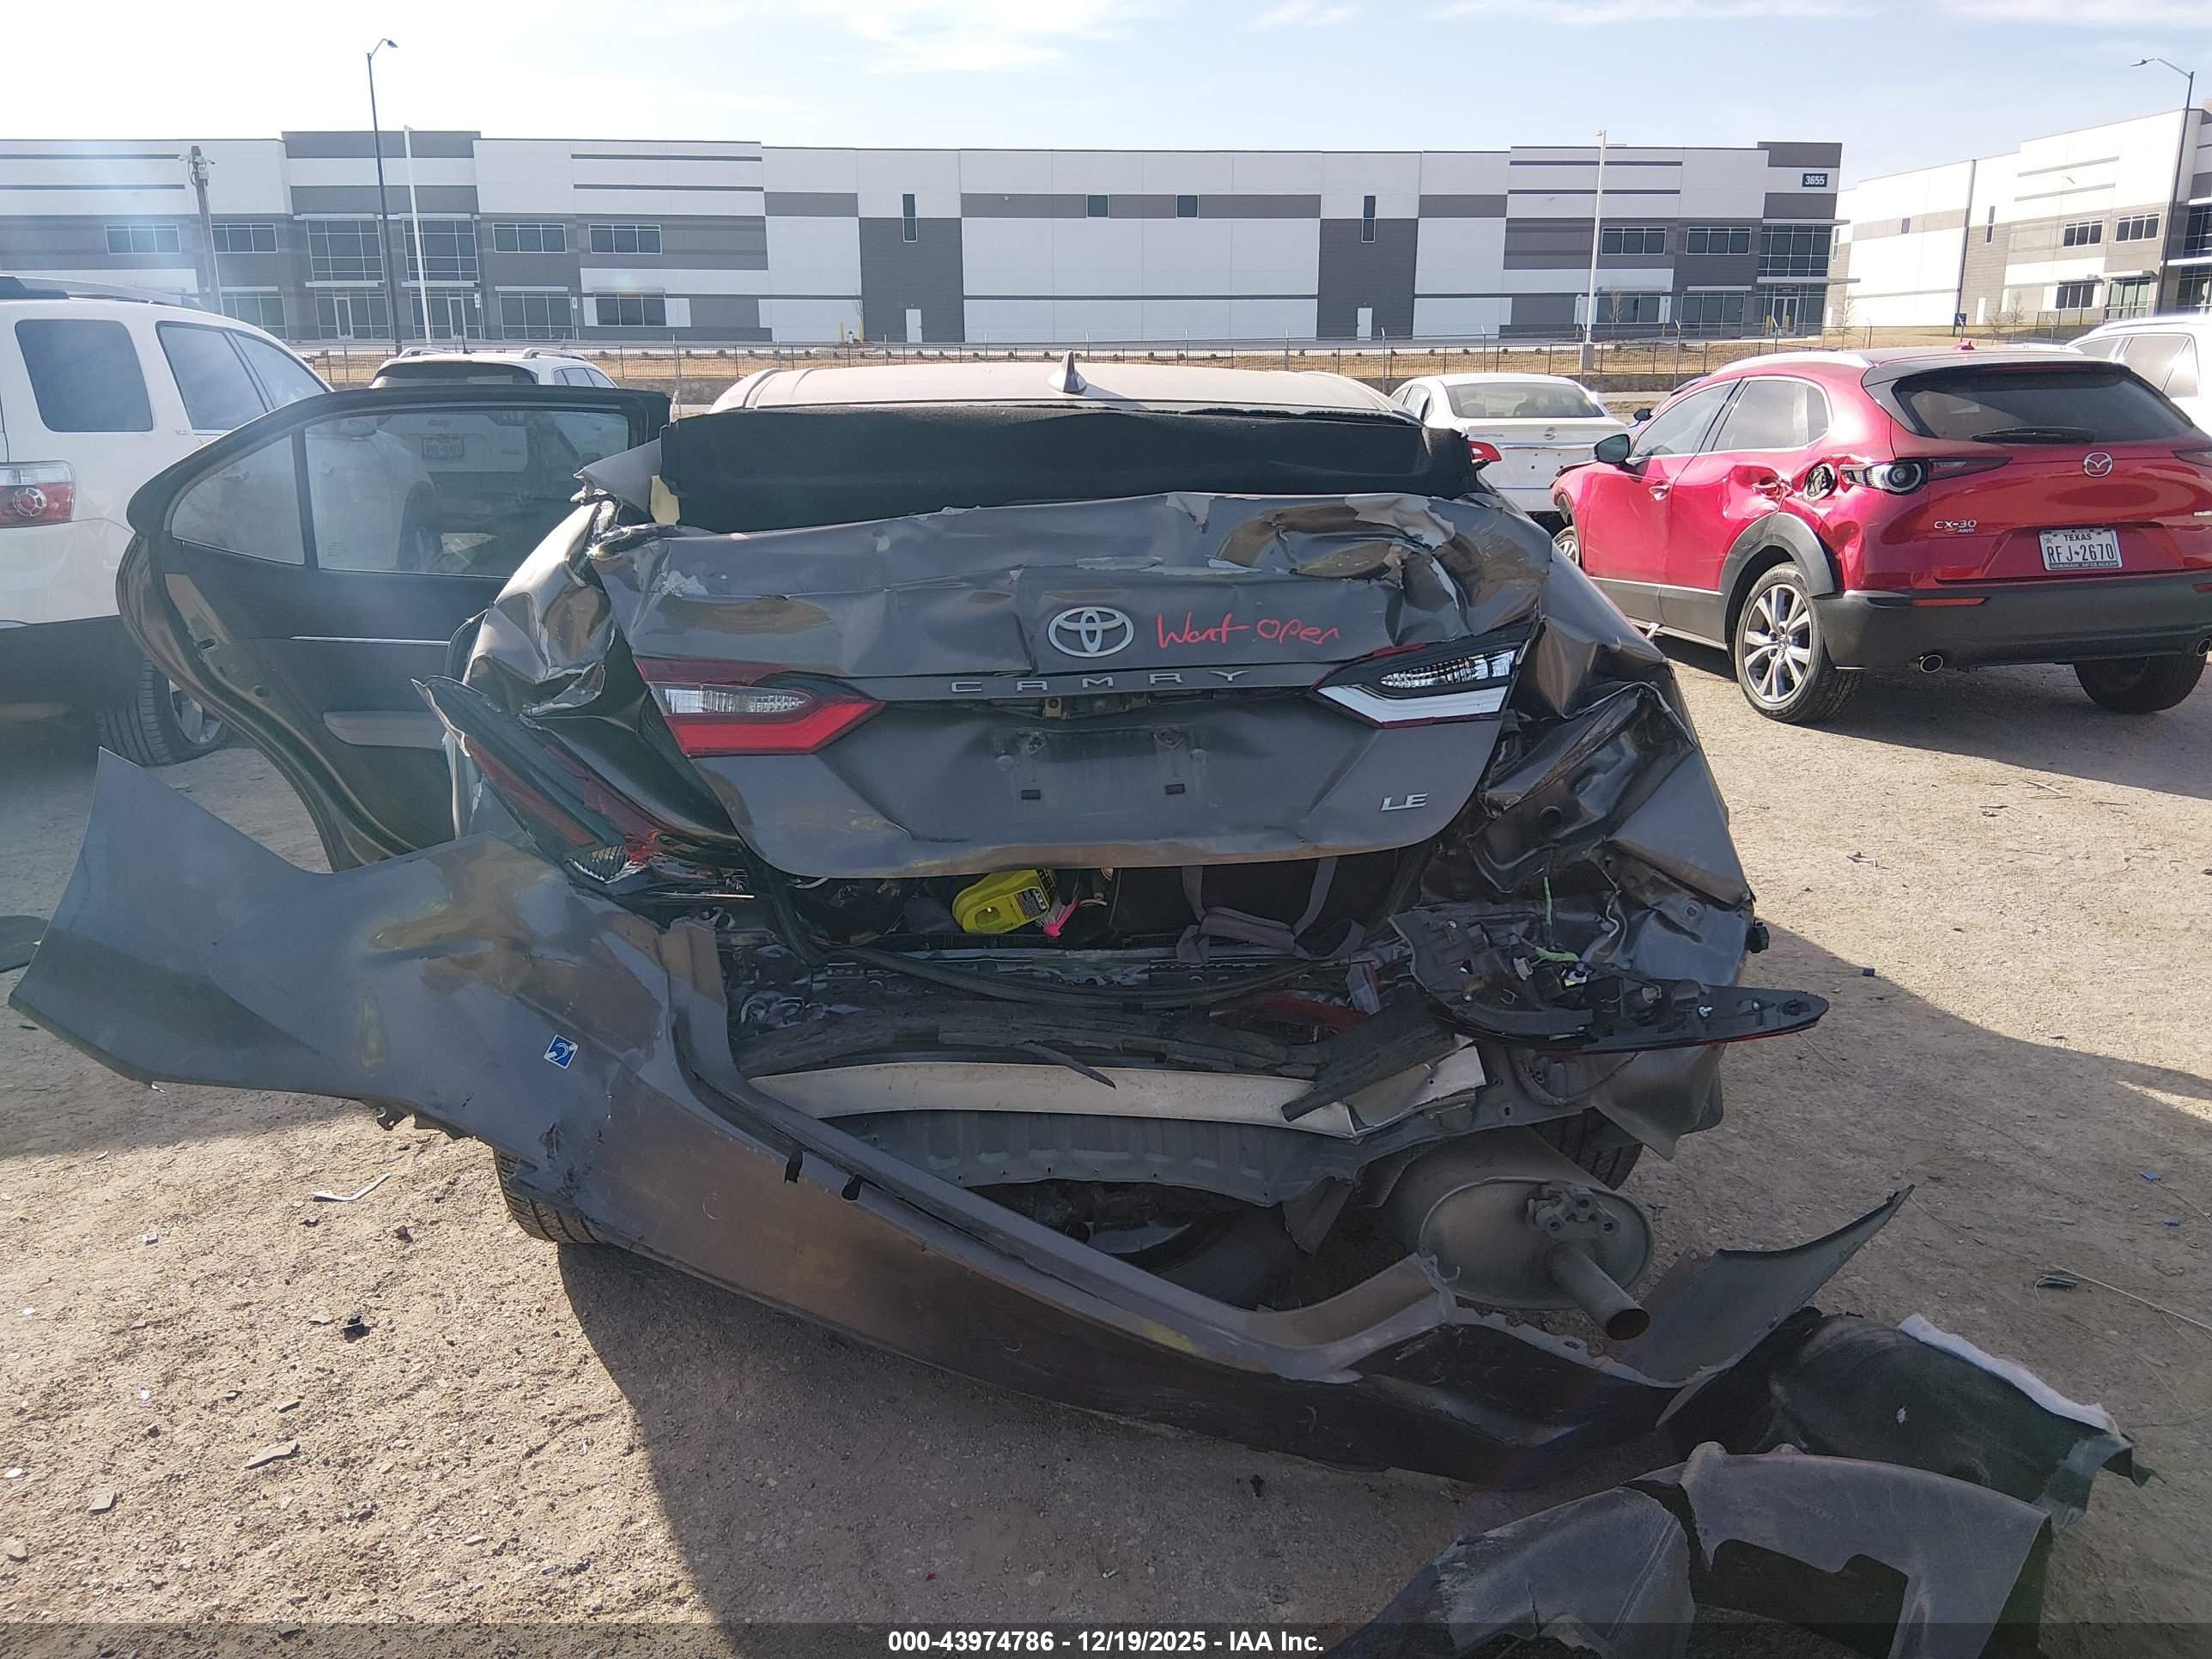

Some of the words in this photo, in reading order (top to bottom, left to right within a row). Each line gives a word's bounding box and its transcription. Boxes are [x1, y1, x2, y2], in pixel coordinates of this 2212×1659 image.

[1805, 175, 1826, 185] 3655
[1934, 520, 1978, 529] CX-30
[2063, 533, 2093, 542] TEXAS
[951, 670, 1249, 692] CAMRY
[1380, 793, 1430, 811] LE
